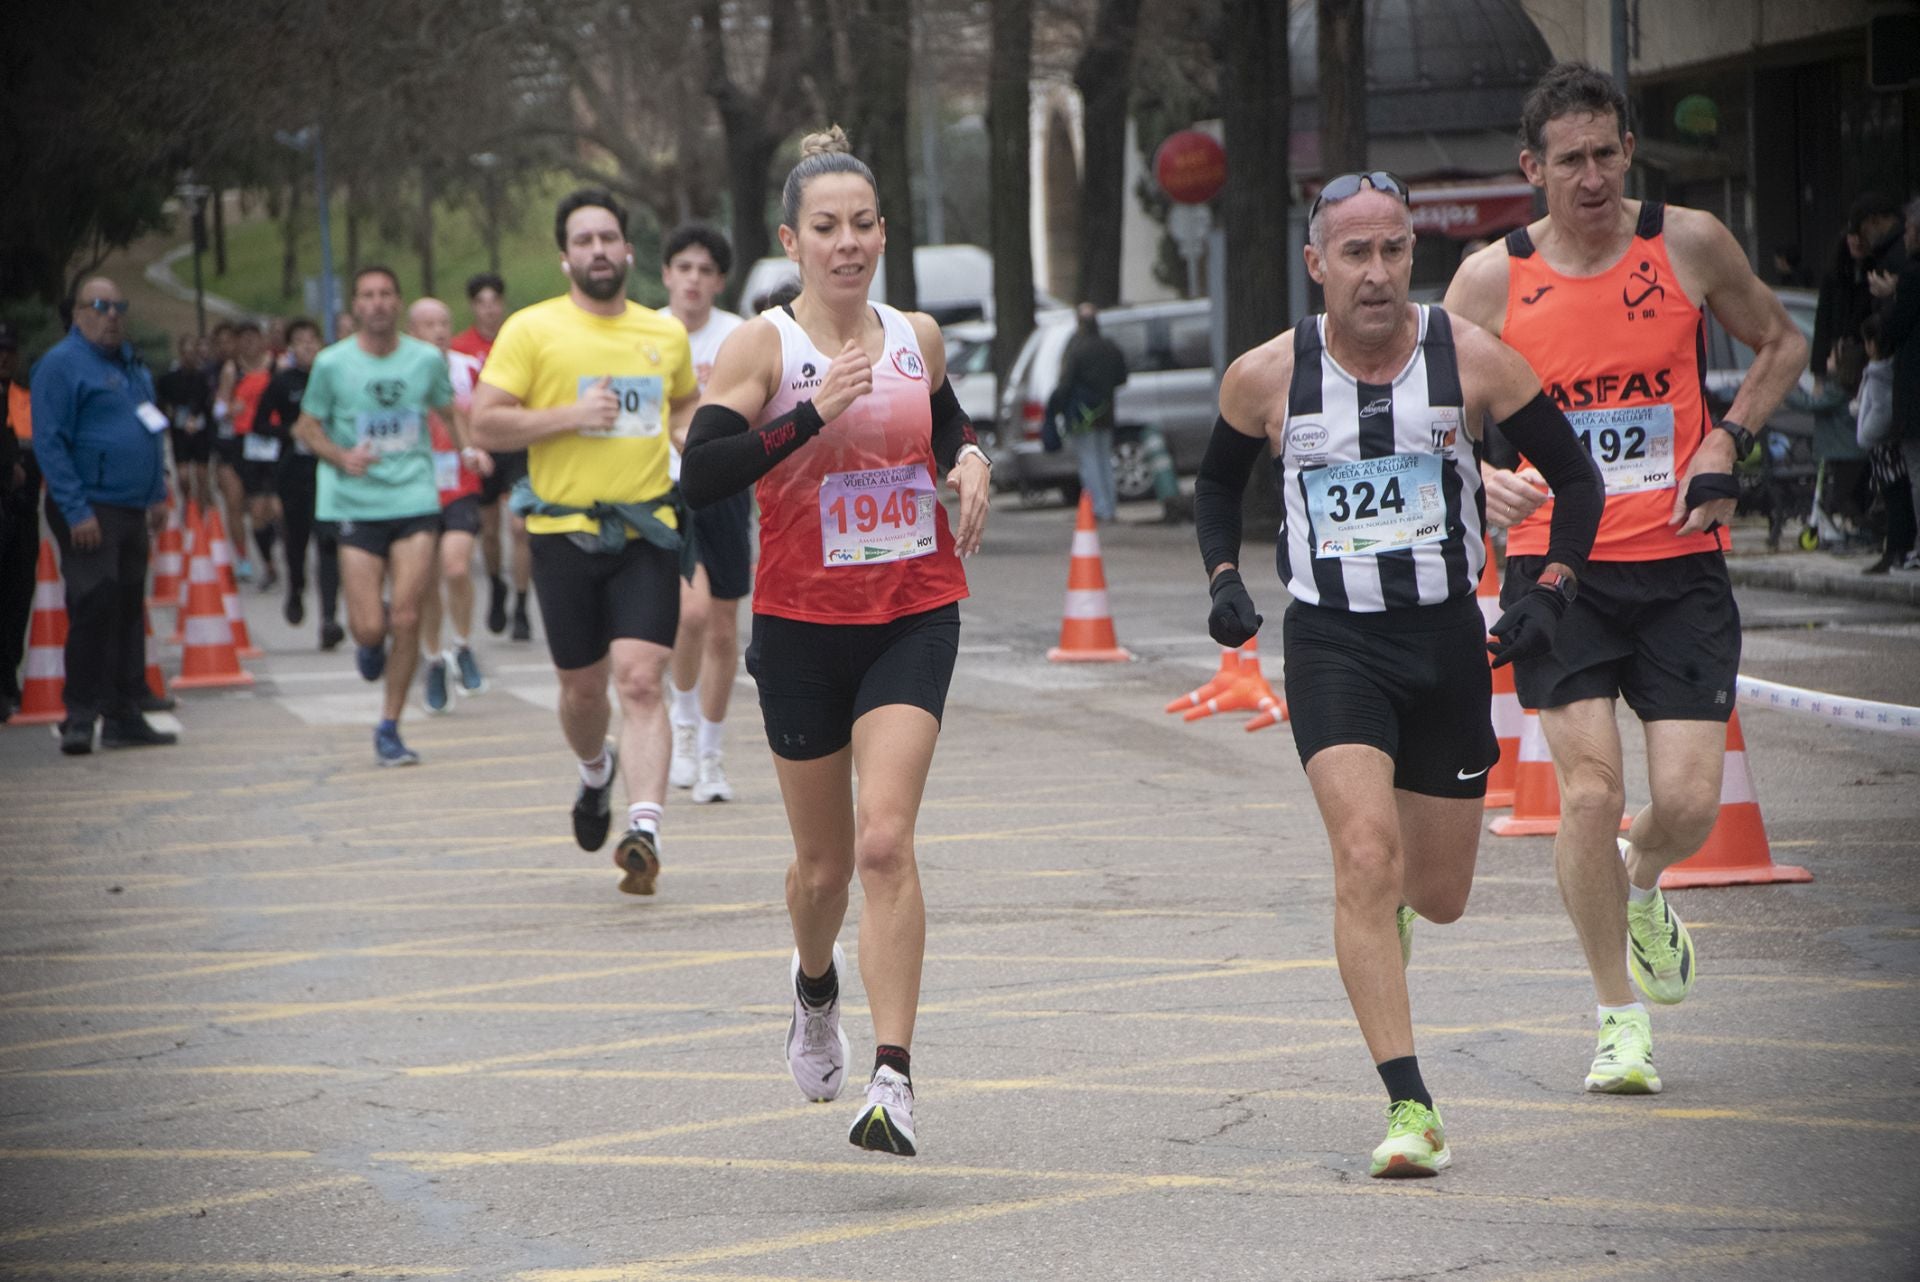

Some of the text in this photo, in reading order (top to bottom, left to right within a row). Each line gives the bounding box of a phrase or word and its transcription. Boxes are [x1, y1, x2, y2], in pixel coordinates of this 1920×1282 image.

[1291, 431, 1326, 443] ALONSO
[1578, 425, 1646, 464] 192
[1329, 470, 1360, 481] VUELTA
[1363, 468, 1375, 476] AL
[1377, 460, 1419, 474] BALUARTE
[1345, 461, 1376, 472] CROSS
[1379, 456, 1419, 466] POPULAR
[861, 470, 891, 479] CROSS
[1644, 471, 1670, 483] HOY
[844, 478, 878, 488] VUELTA
[880, 477, 890, 485] AL
[1326, 476, 1405, 523] 324
[829, 488, 917, 534] 1946
[1416, 524, 1440, 537] HOY
[916, 536, 933, 548] HOY
